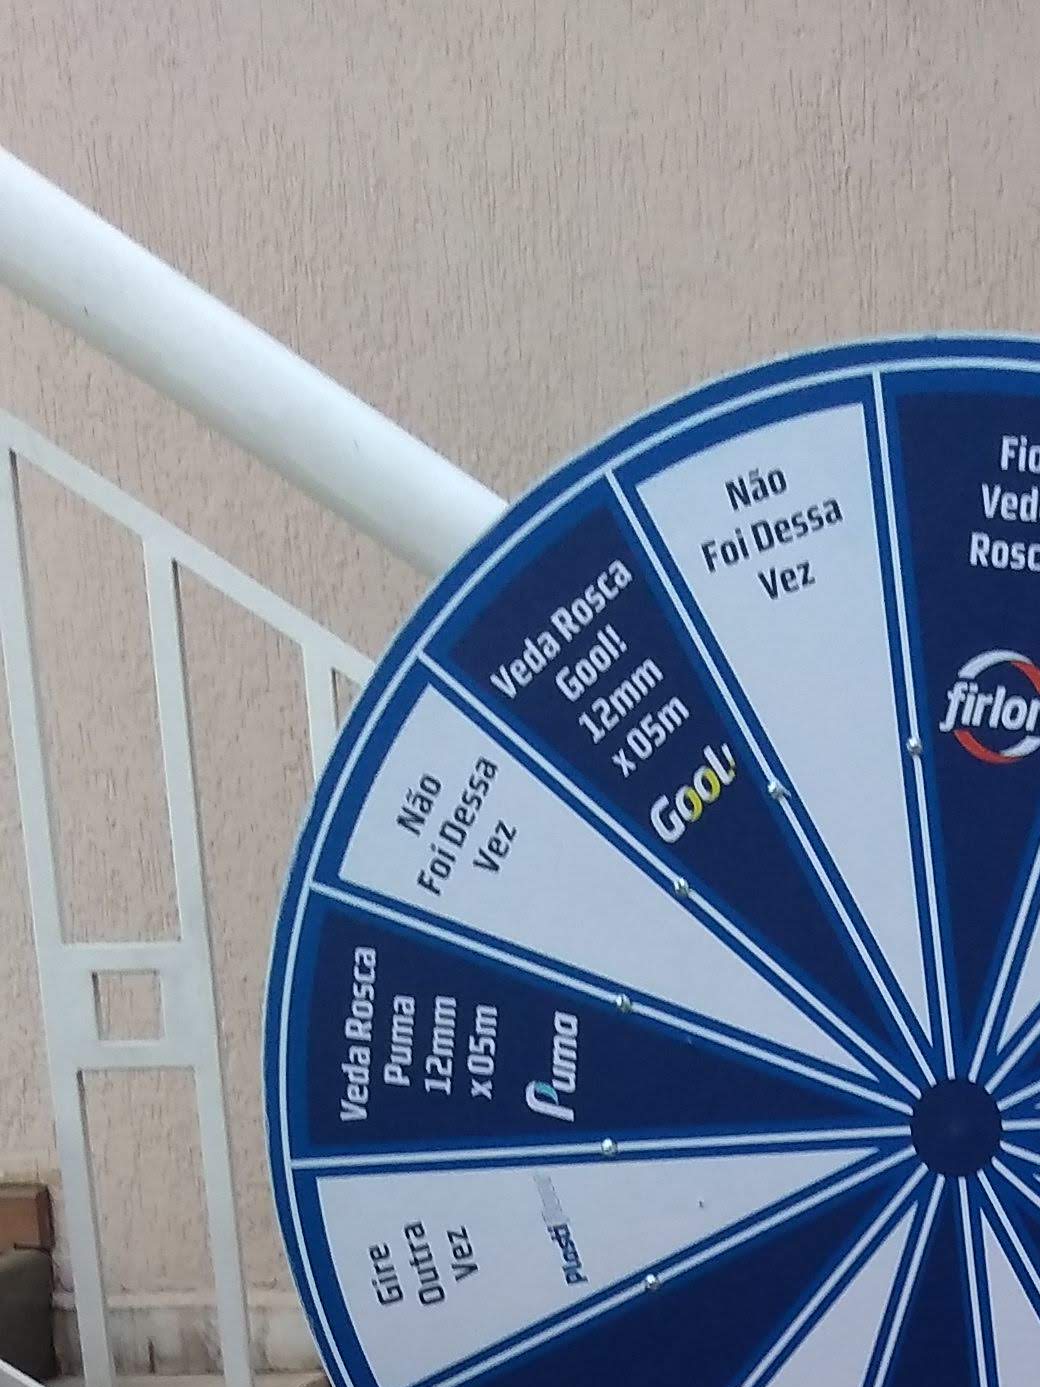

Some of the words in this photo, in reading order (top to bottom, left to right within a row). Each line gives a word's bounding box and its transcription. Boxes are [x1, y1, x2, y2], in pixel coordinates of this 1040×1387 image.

[725, 468, 787, 511] Não
[701, 527, 750, 573] Foi
[750, 499, 843, 553] Dessa
[757, 561, 816, 600] Vez
[489, 631, 561, 699] Veda
[551, 559, 633, 643] Rosca
[555, 625, 628, 702] Gool!
[578, 658, 664, 744] 12mm
[611, 748, 637, 778] x
[626, 697, 690, 760] 05m
[395, 774, 442, 836] Não
[416, 842, 456, 896] Foi
[439, 756, 498, 848] Dessa
[472, 819, 517, 873] Vez
[344, 946, 377, 1042] Rosca
[383, 995, 416, 1086] Puma
[424, 995, 457, 1096] 12mm
[466, 1004, 498, 1076] 05m
[525, 1010, 578, 1122] Puma
[339, 1045, 371, 1121] Veda
[470, 1080, 492, 1100] x
[369, 1243, 404, 1306] Gire
[404, 1221, 446, 1307] Outra
[446, 1225, 479, 1282] Vez
